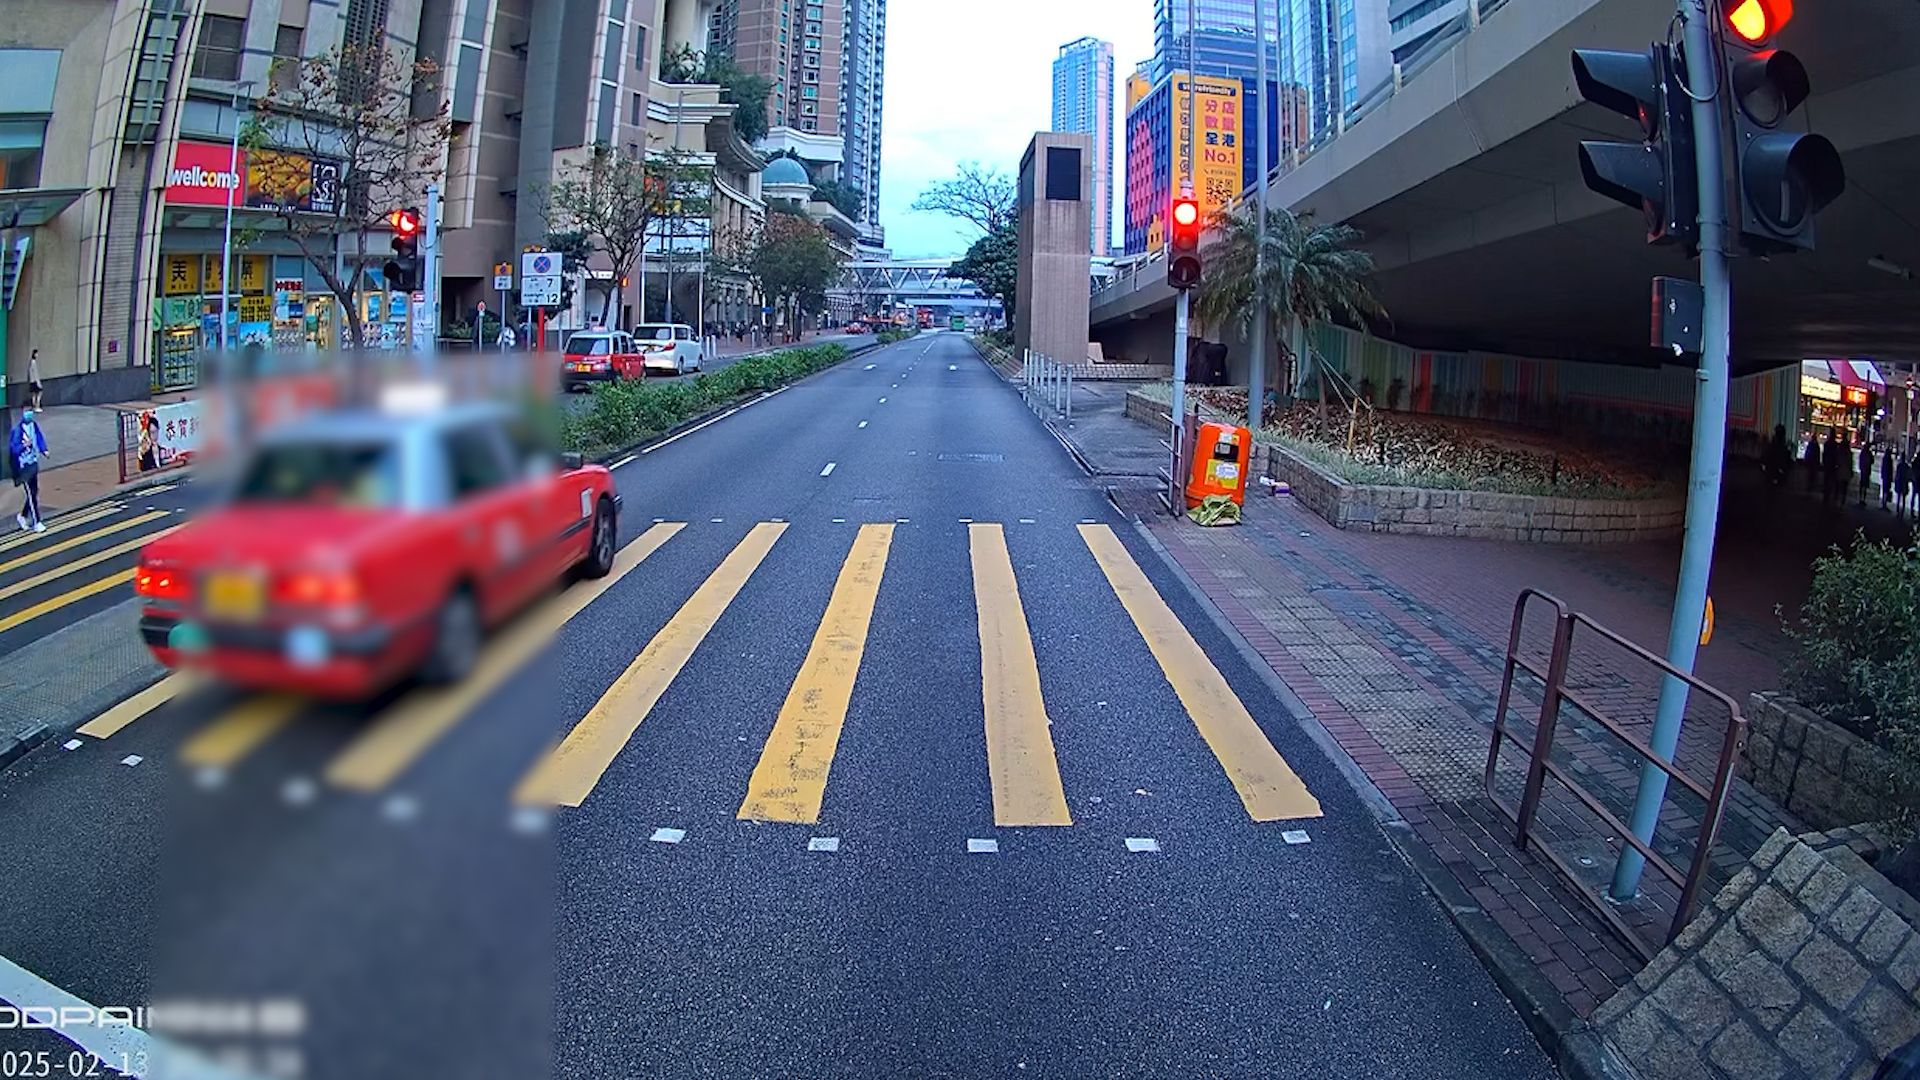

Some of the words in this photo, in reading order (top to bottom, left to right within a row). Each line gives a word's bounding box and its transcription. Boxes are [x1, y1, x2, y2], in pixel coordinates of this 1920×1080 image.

[1205, 132, 1235, 147] 全港
[1205, 149, 1236, 164] No.1
[547, 278, 553, 288] 7
[547, 293, 558, 303] 12
